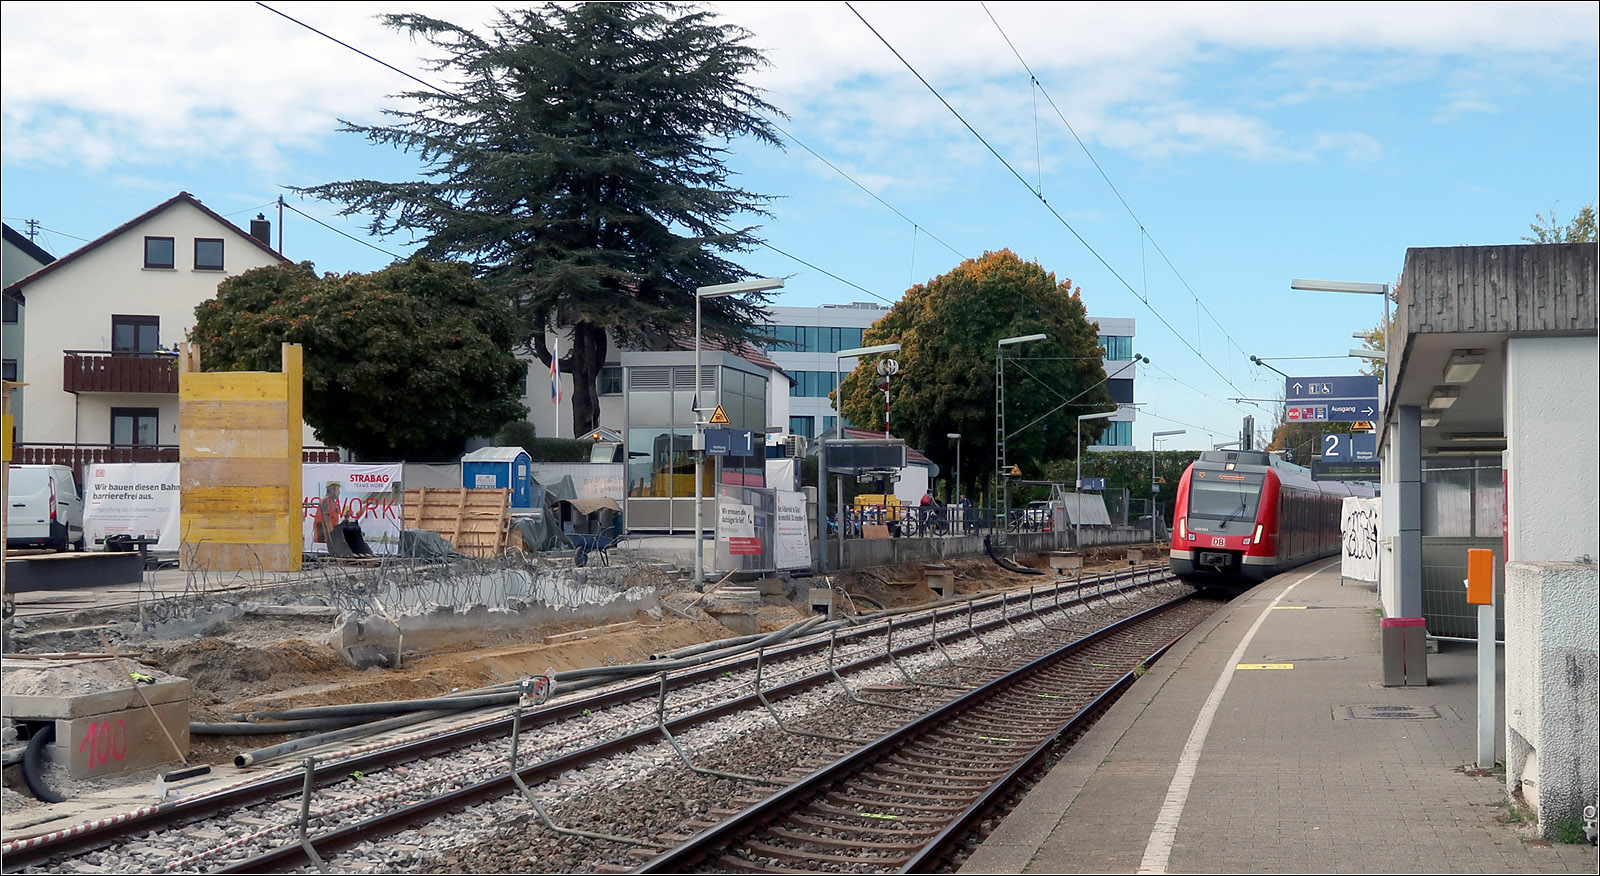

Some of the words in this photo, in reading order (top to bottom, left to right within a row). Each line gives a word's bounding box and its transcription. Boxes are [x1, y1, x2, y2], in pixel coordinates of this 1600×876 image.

[744, 431, 751, 451] 1
[1325, 434, 1339, 456] 2
[349, 474, 389, 483] STRABAG
[1100, 478, 1105, 488] 1
[94, 483, 107, 491] Wir
[108, 483, 134, 491] bauen
[135, 483, 159, 491] diesen
[160, 483, 180, 491] Bahn
[92, 492, 138, 500] barrierefrei
[1212, 538, 1225, 546] DB
[79, 718, 127, 770] 100
